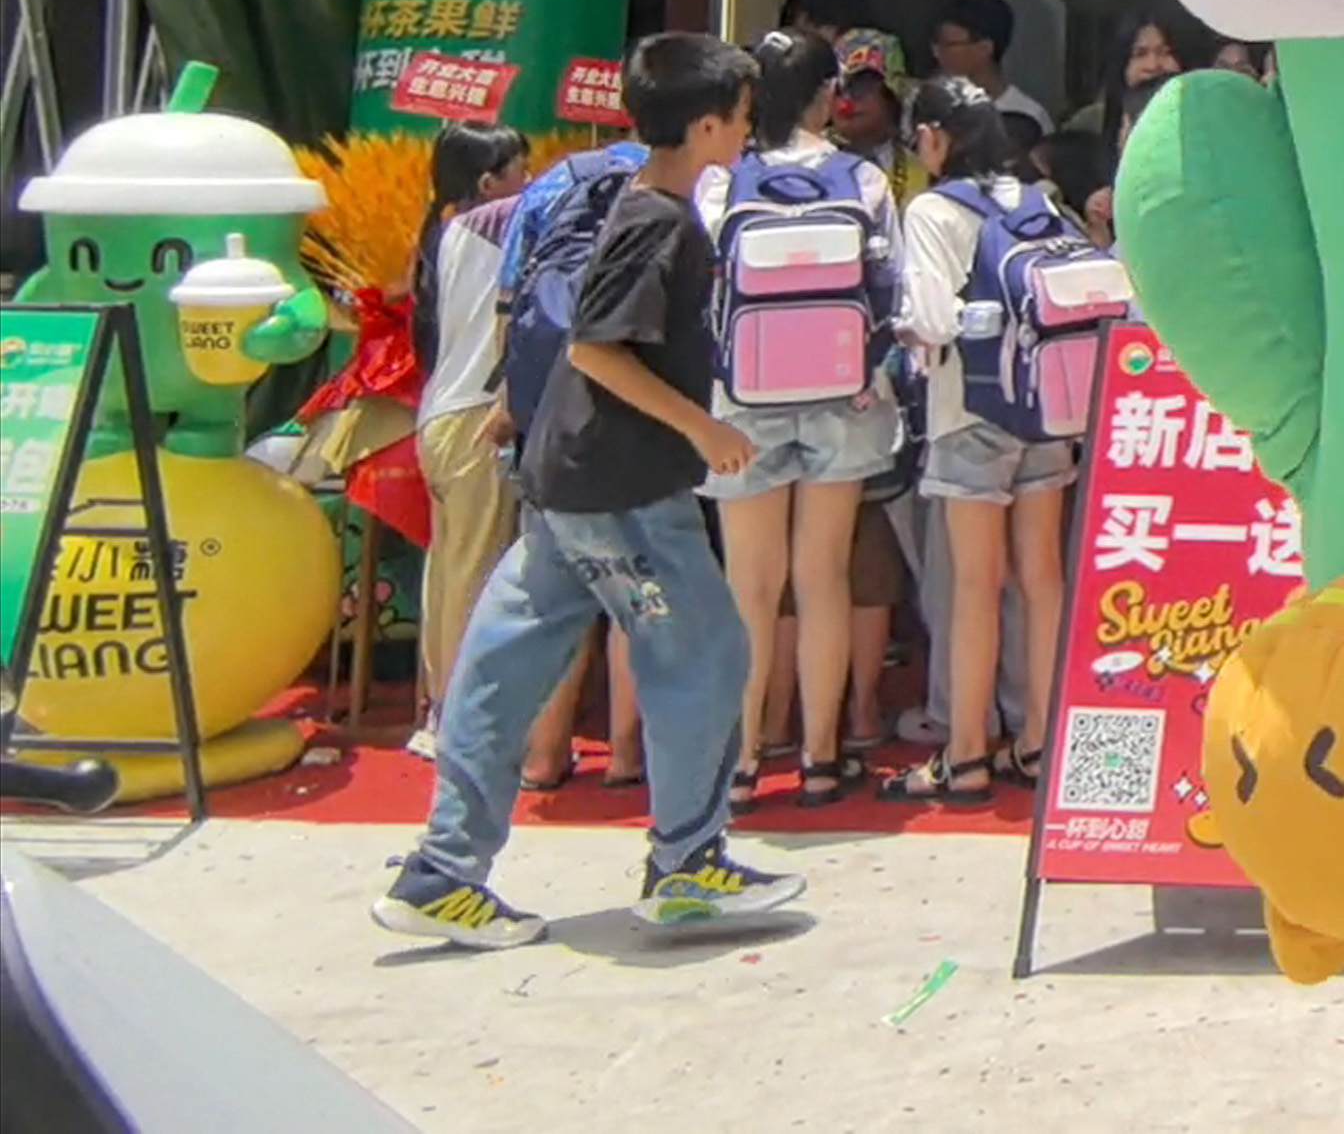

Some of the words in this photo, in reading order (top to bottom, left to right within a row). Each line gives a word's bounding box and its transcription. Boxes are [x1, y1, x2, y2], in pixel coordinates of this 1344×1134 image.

[39, 589, 197, 634] WEE
[1097, 580, 1233, 643] Sweet
[28, 637, 170, 679] IANG
